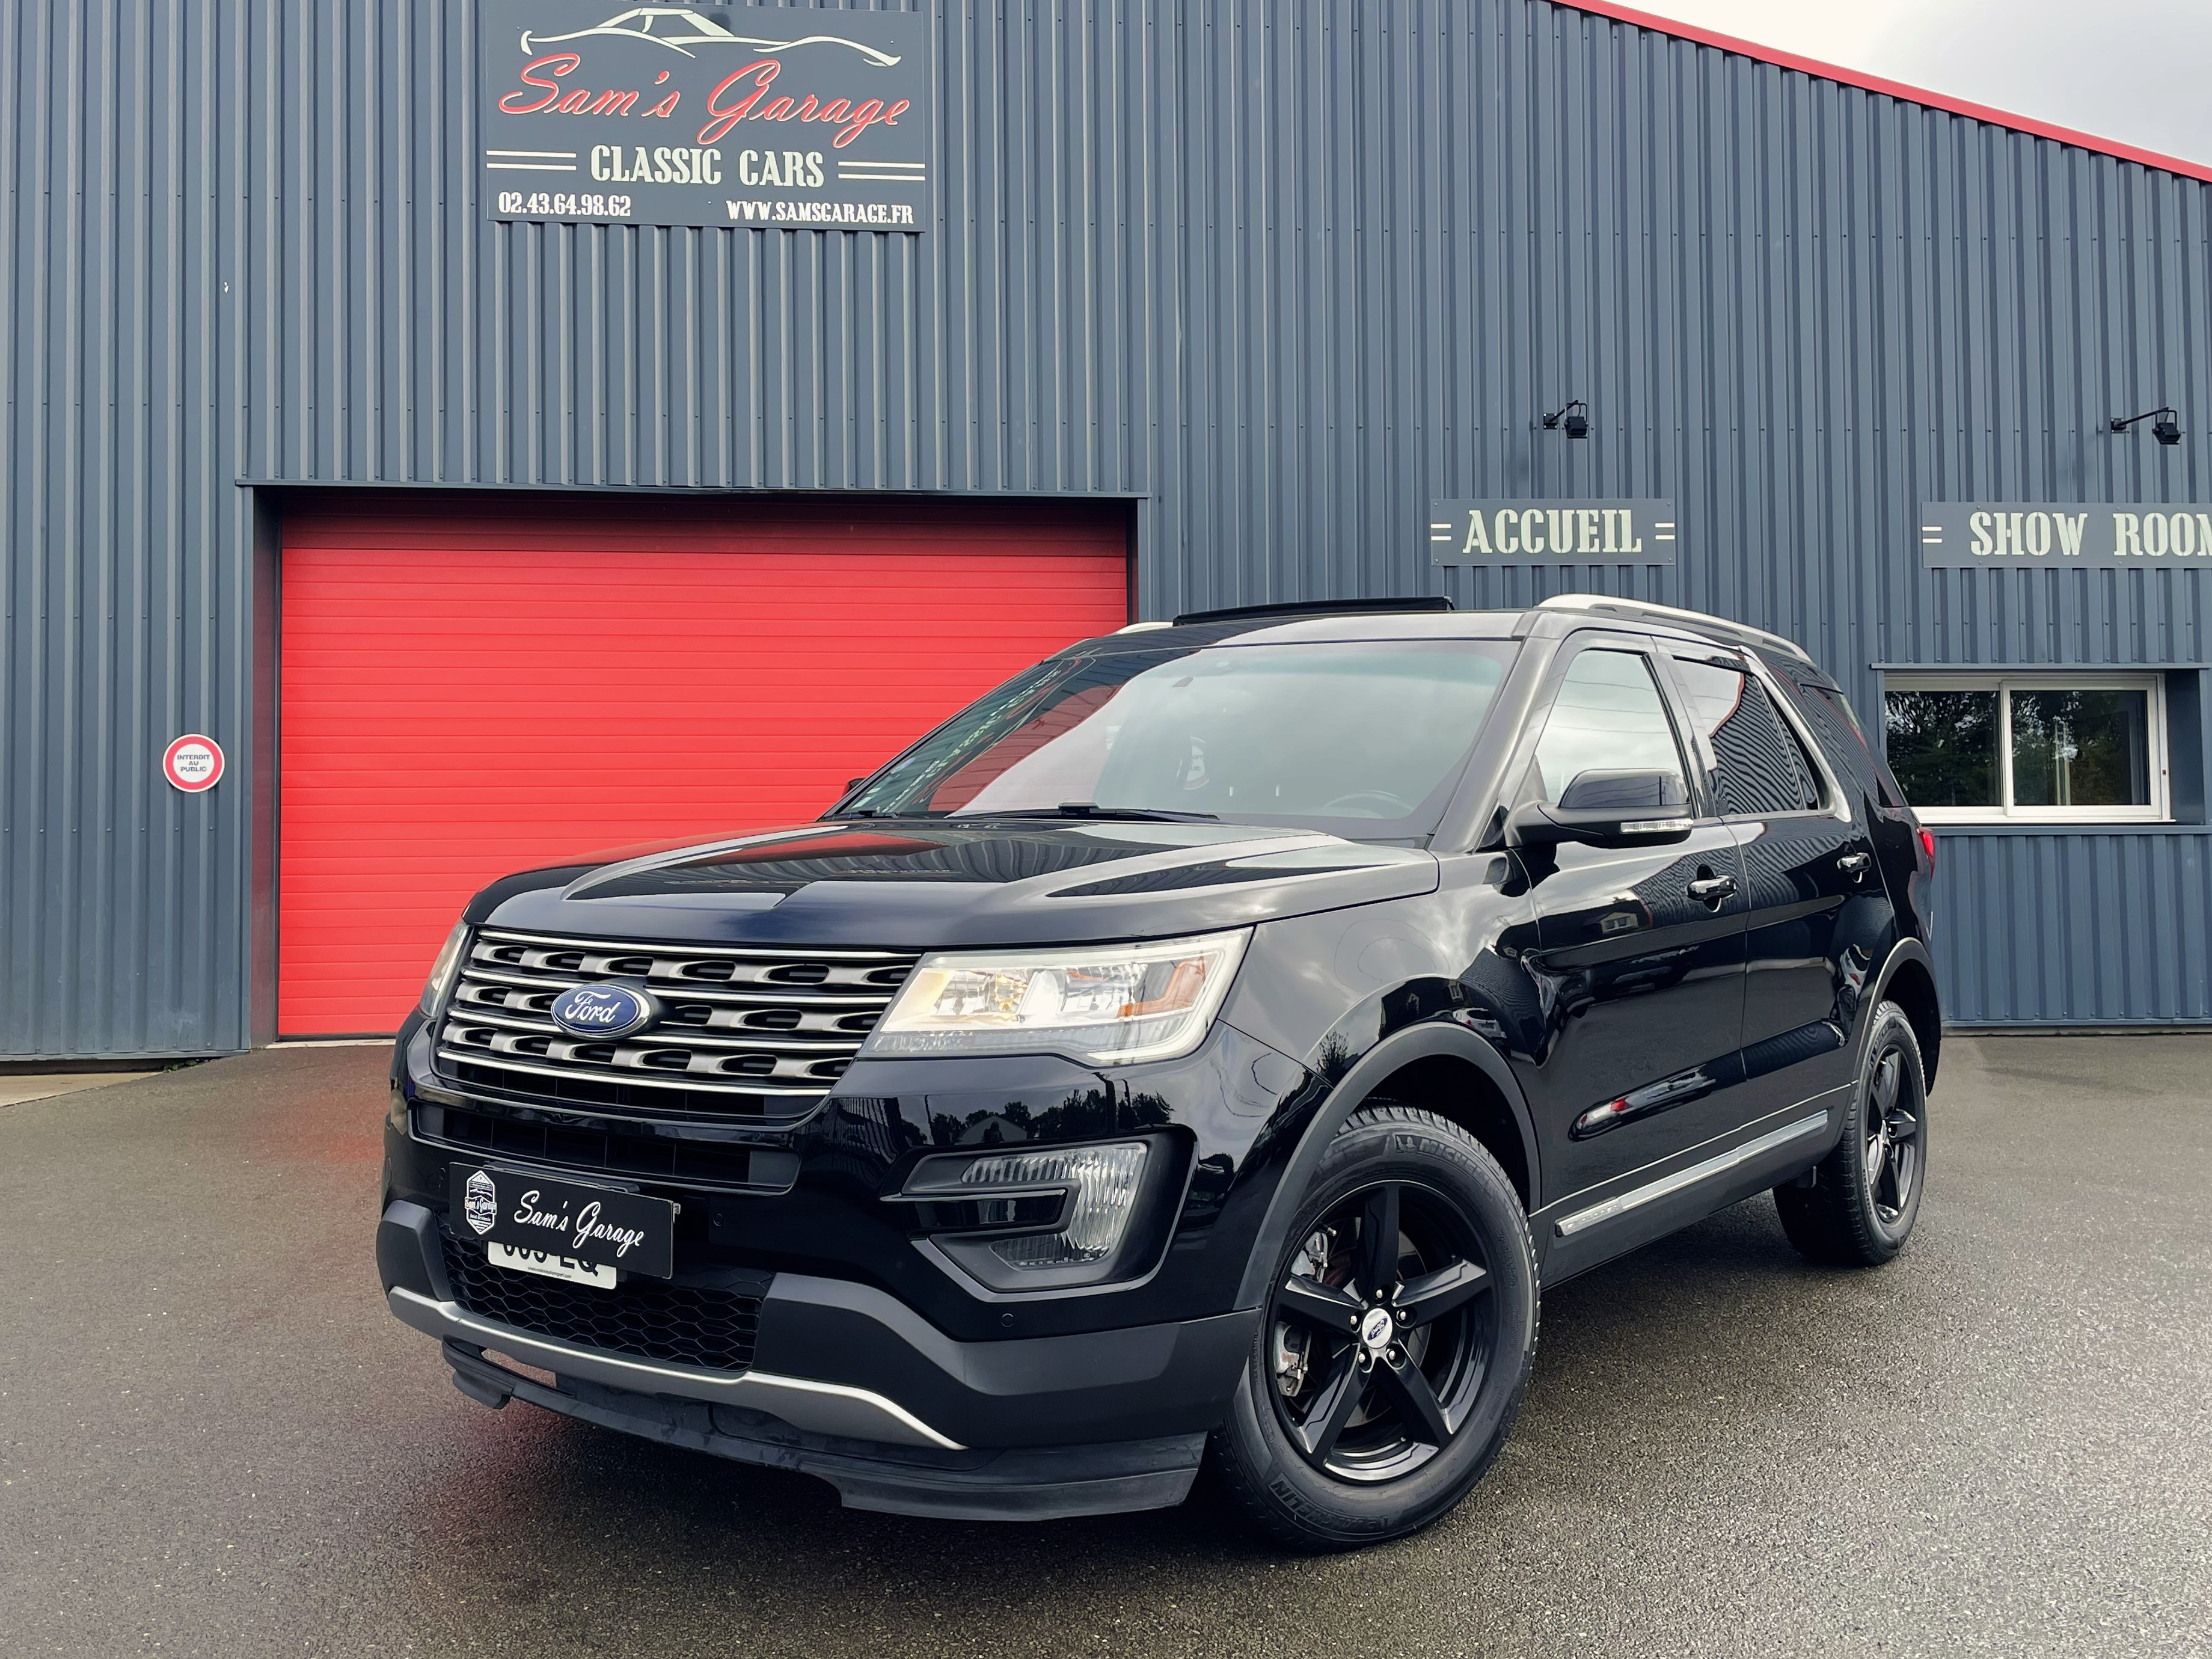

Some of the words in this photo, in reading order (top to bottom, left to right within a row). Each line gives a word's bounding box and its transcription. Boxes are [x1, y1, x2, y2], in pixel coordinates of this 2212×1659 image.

[498, 52, 681, 117] Sam's
[697, 59, 910, 149] Garage
[590, 145, 721, 185] CLASSIC
[740, 149, 824, 188] CARS
[498, 191, 631, 216] 02.43.64.98.62
[726, 199, 914, 224] WWW.SAMSGARAGE.FR
[1462, 508, 1643, 554] ACCUEIL
[1970, 511, 2088, 556] SHOW
[565, 991, 621, 1023] Ford
[513, 1189, 569, 1231] Sam's
[572, 1201, 645, 1258] Garage
